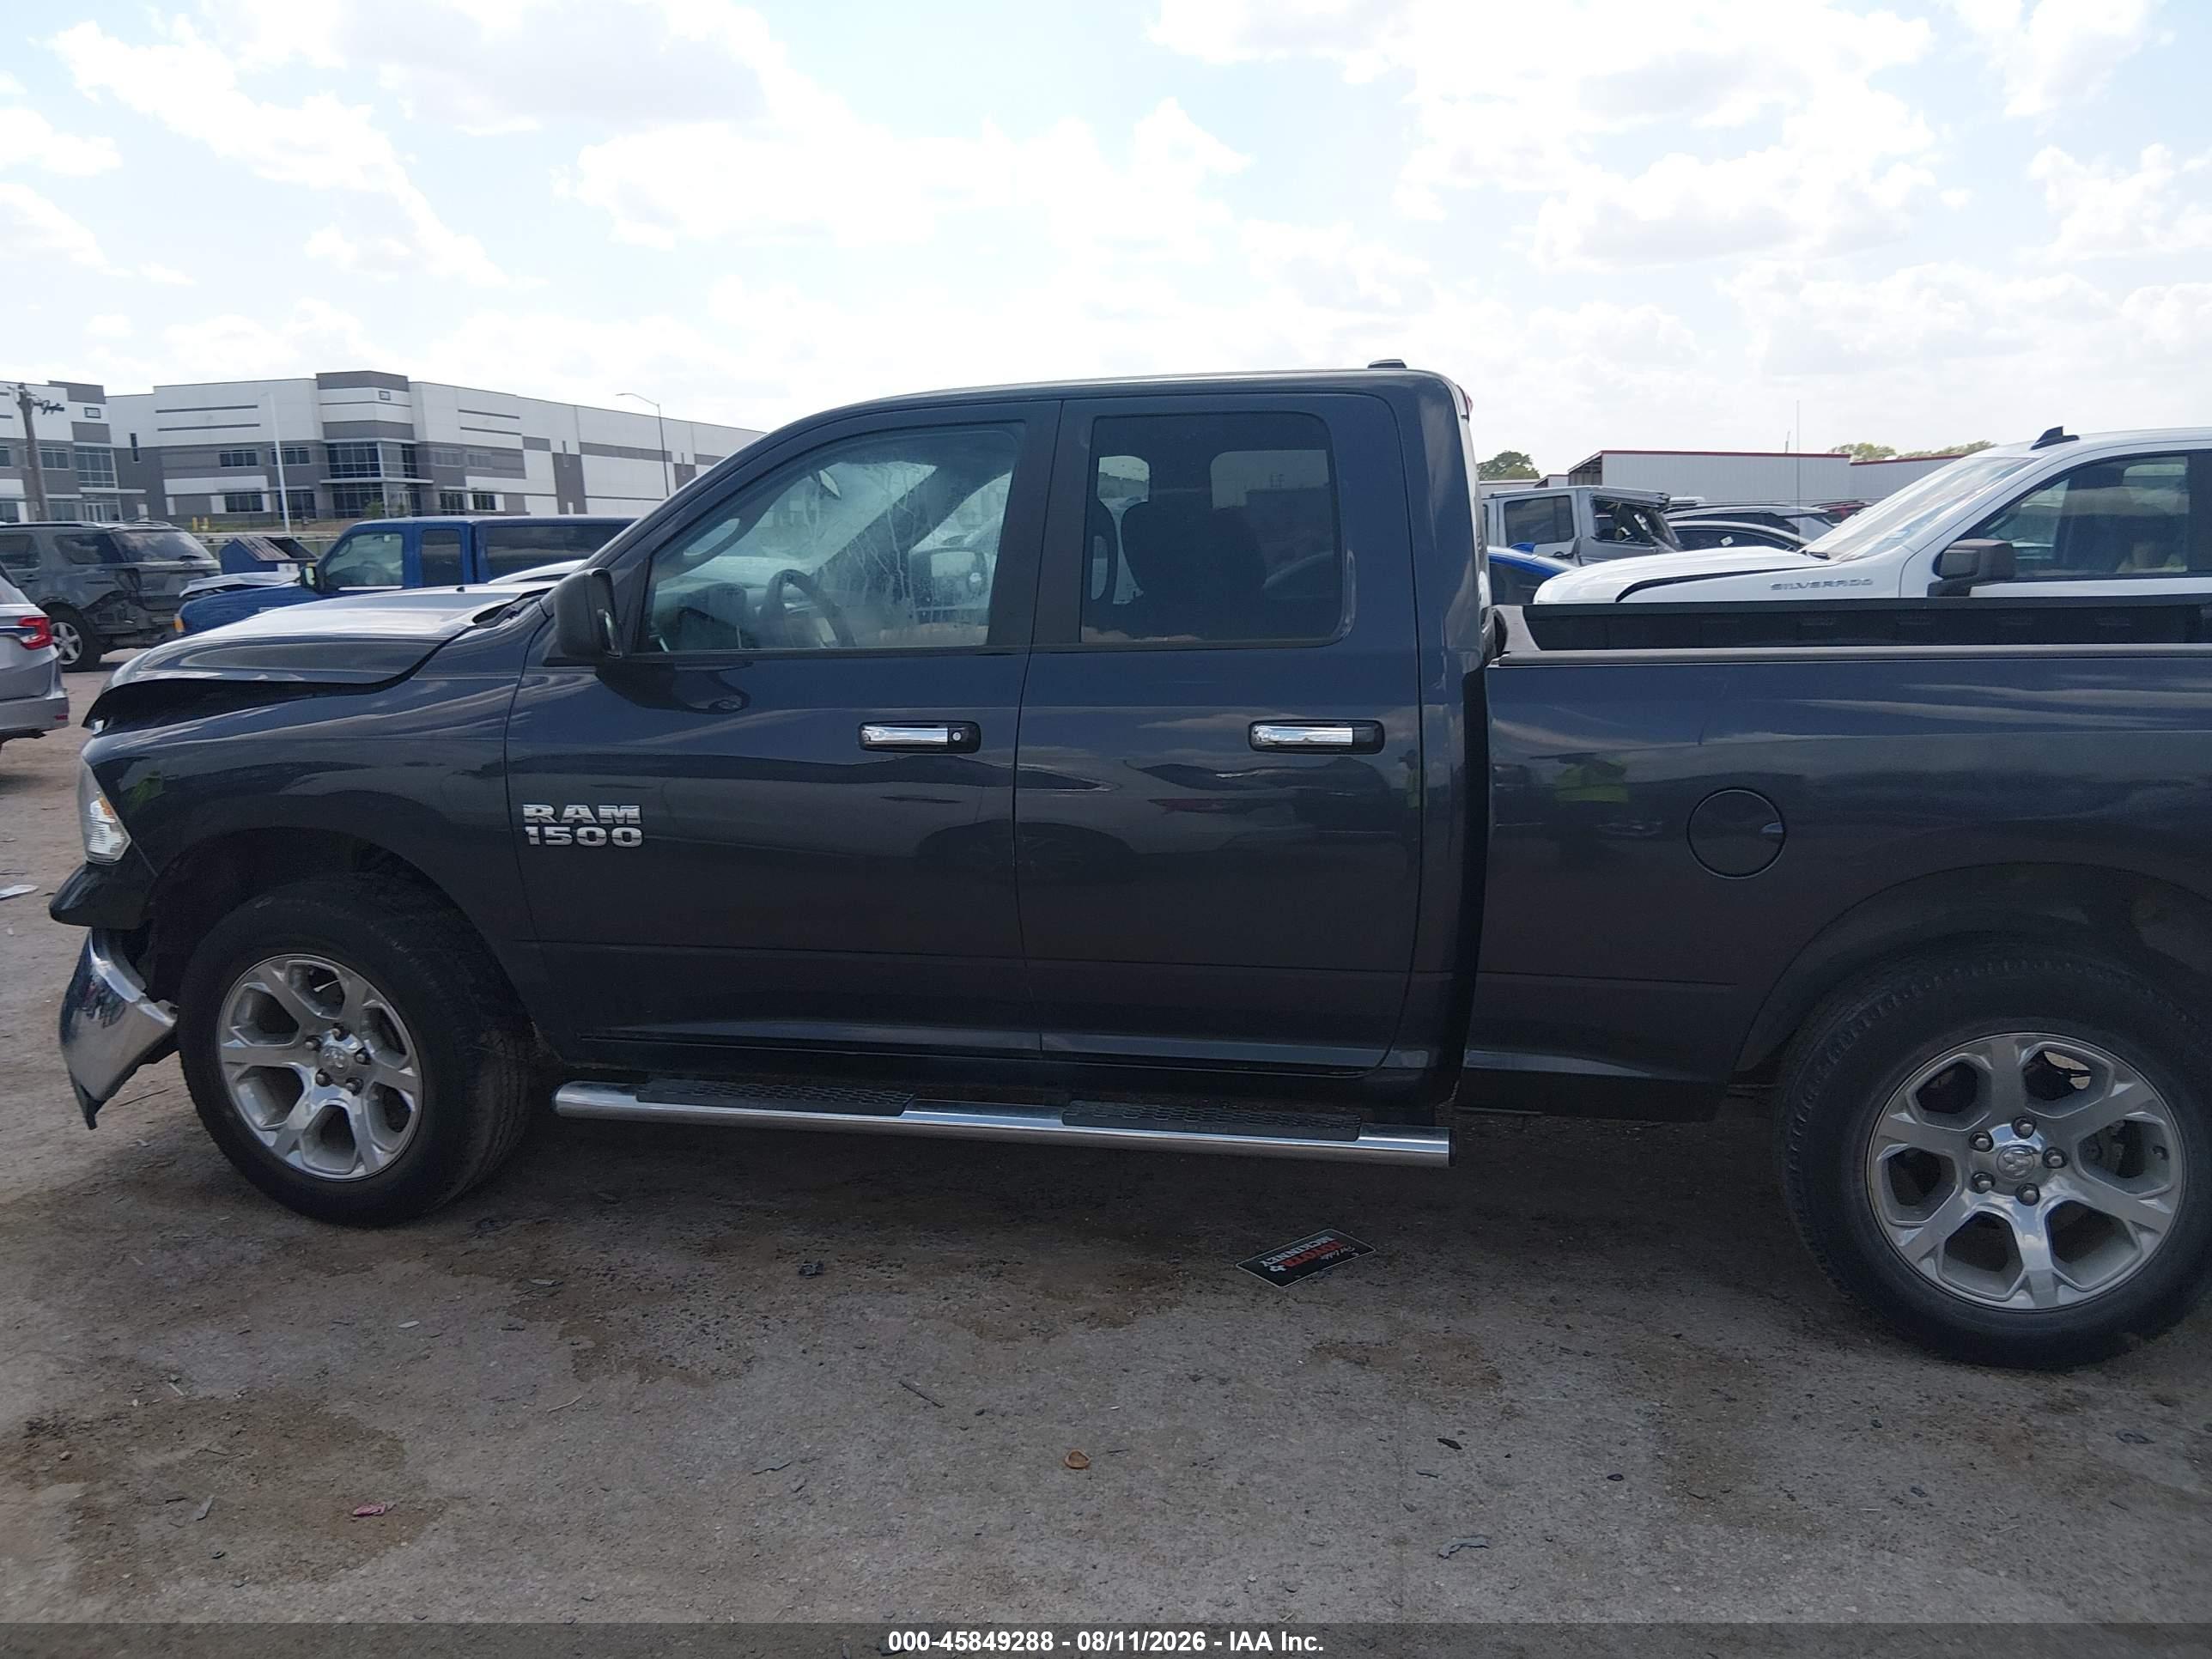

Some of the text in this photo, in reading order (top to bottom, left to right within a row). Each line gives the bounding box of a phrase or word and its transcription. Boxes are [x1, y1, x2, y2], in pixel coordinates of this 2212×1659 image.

[1771, 578, 1873, 591] SILVERADO
[522, 805, 641, 824] RAM
[525, 826, 642, 848] 1500
